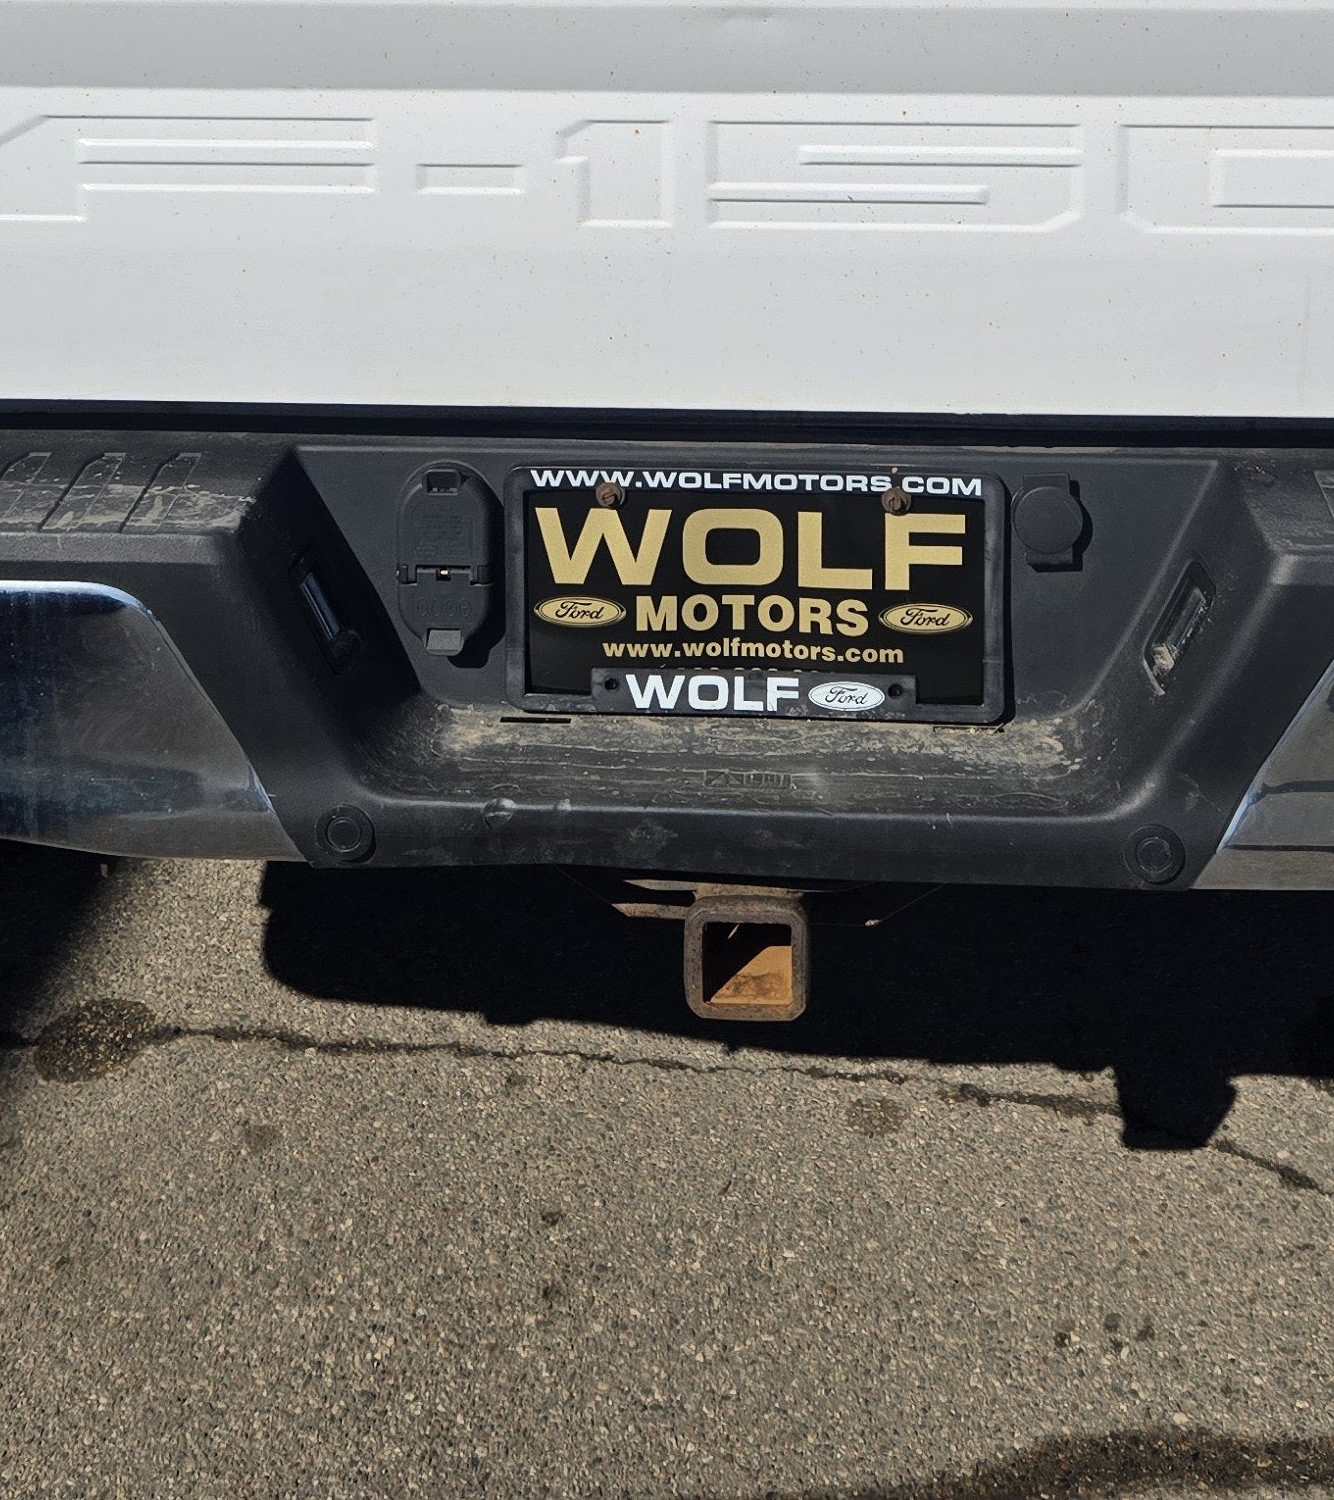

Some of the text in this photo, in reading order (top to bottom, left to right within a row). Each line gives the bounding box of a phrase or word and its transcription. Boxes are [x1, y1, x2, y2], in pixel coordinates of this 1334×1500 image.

[530, 469, 982, 497] WWW.WOLFMOTORSCOM
[534, 506, 966, 591] WOLF
[553, 601, 605, 623] Ford
[635, 594, 869, 637] MOTORS
[901, 606, 951, 628] Ford
[602, 637, 904, 663] www.wolfmotors.com
[625, 673, 869, 712] WOLF Ford
